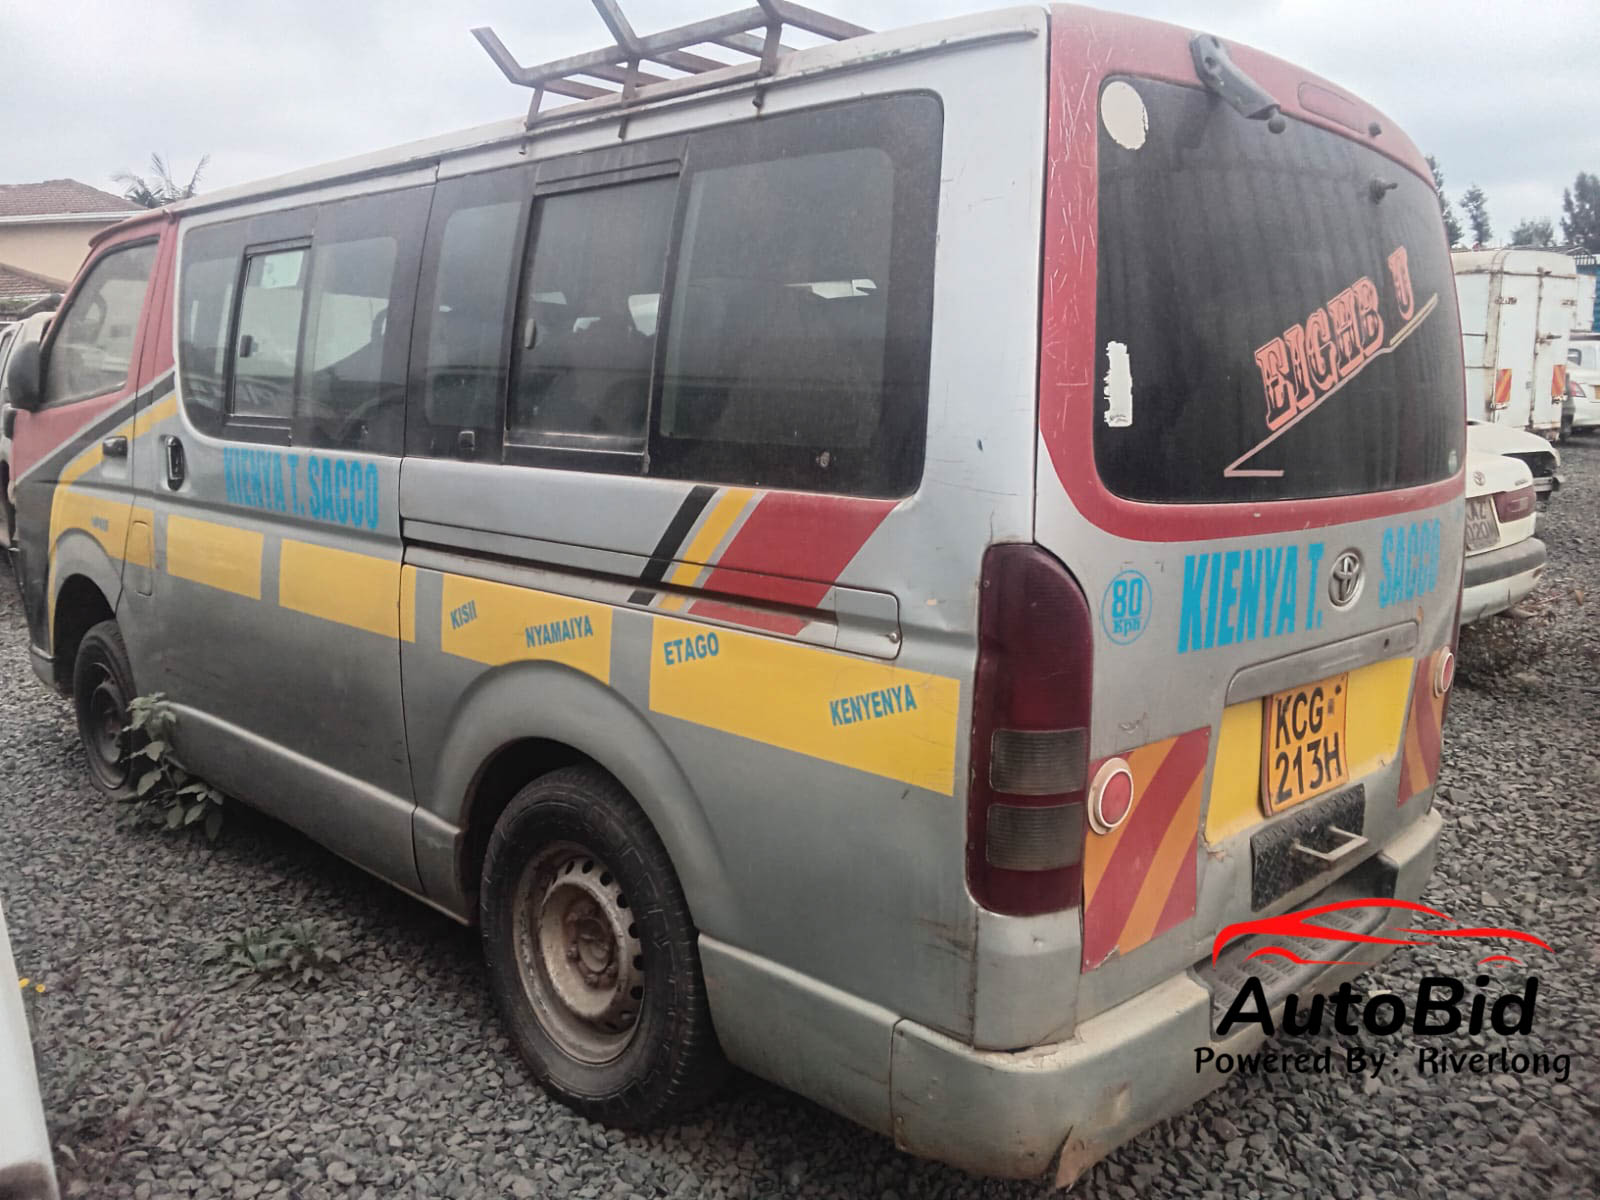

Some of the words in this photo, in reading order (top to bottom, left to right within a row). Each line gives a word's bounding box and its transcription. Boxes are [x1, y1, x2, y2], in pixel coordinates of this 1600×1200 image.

[307, 455, 379, 530] SACCO
[1111, 577, 1144, 619] 80
[1177, 544, 1299, 654] KIENYA
[1304, 542, 1325, 631] T.
[1377, 517, 1441, 609] SACCO
[450, 600, 478, 629] KISII
[525, 615, 594, 648] NYAMAIYA
[663, 631, 720, 666] ETAGO
[829, 683, 918, 727] KENYENYA
[1275, 686, 1325, 749] KCG
[1275, 731, 1343, 804] 213H
